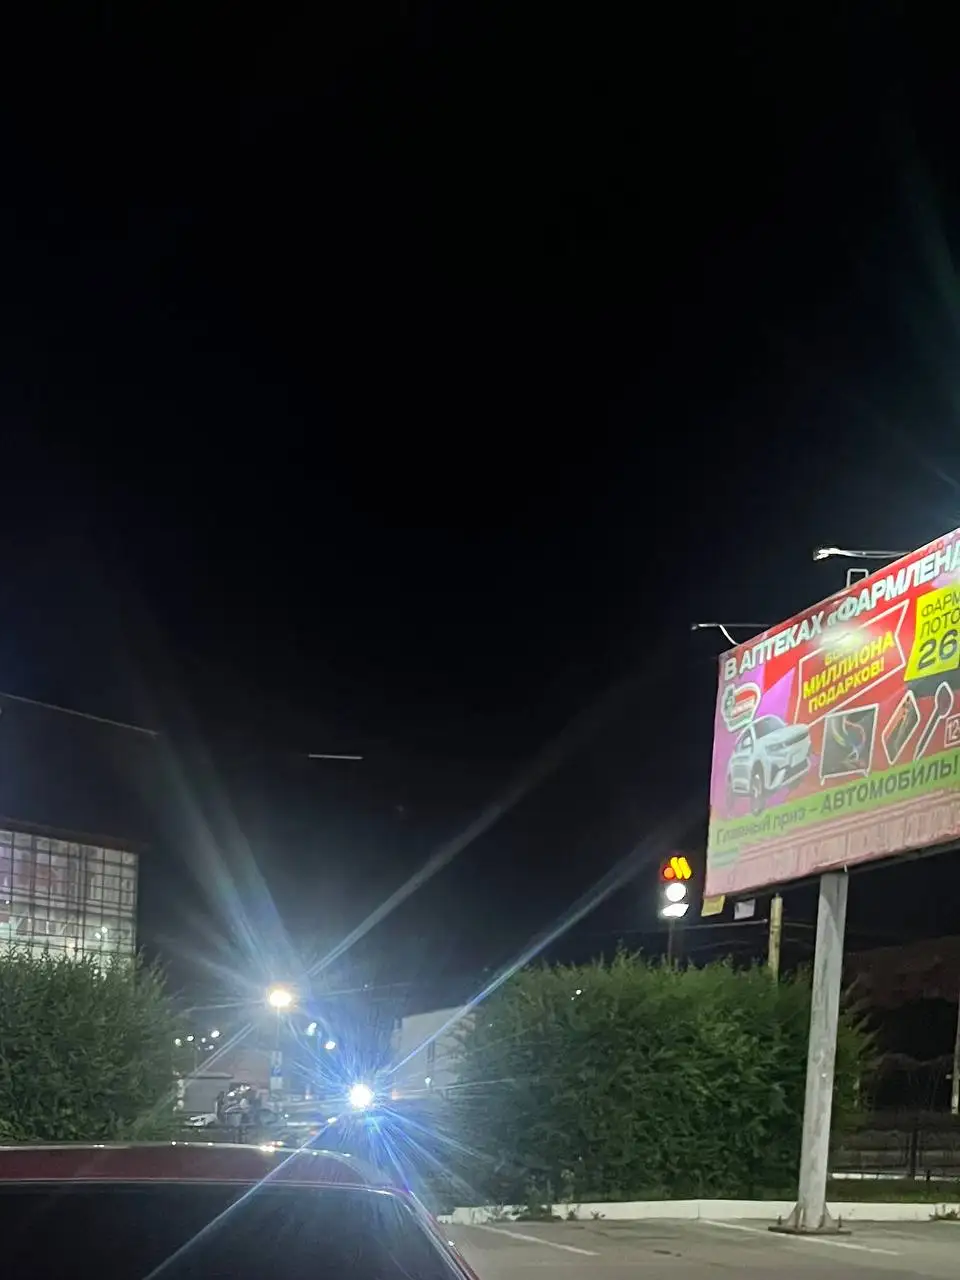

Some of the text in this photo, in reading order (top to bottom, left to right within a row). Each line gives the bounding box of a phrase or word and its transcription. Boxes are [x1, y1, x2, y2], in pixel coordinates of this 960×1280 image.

[724, 656, 738, 681] В
[739, 610, 824, 674] АПТЕКАХ
[803, 630, 896, 700] МИЛЛИОНА
[918, 628, 958, 671] 26
[808, 655, 885, 714] ПОДАРКОВ!
[772, 805, 807, 832] приз
[819, 754, 959, 816] АВТОМОБИЛЬ!
